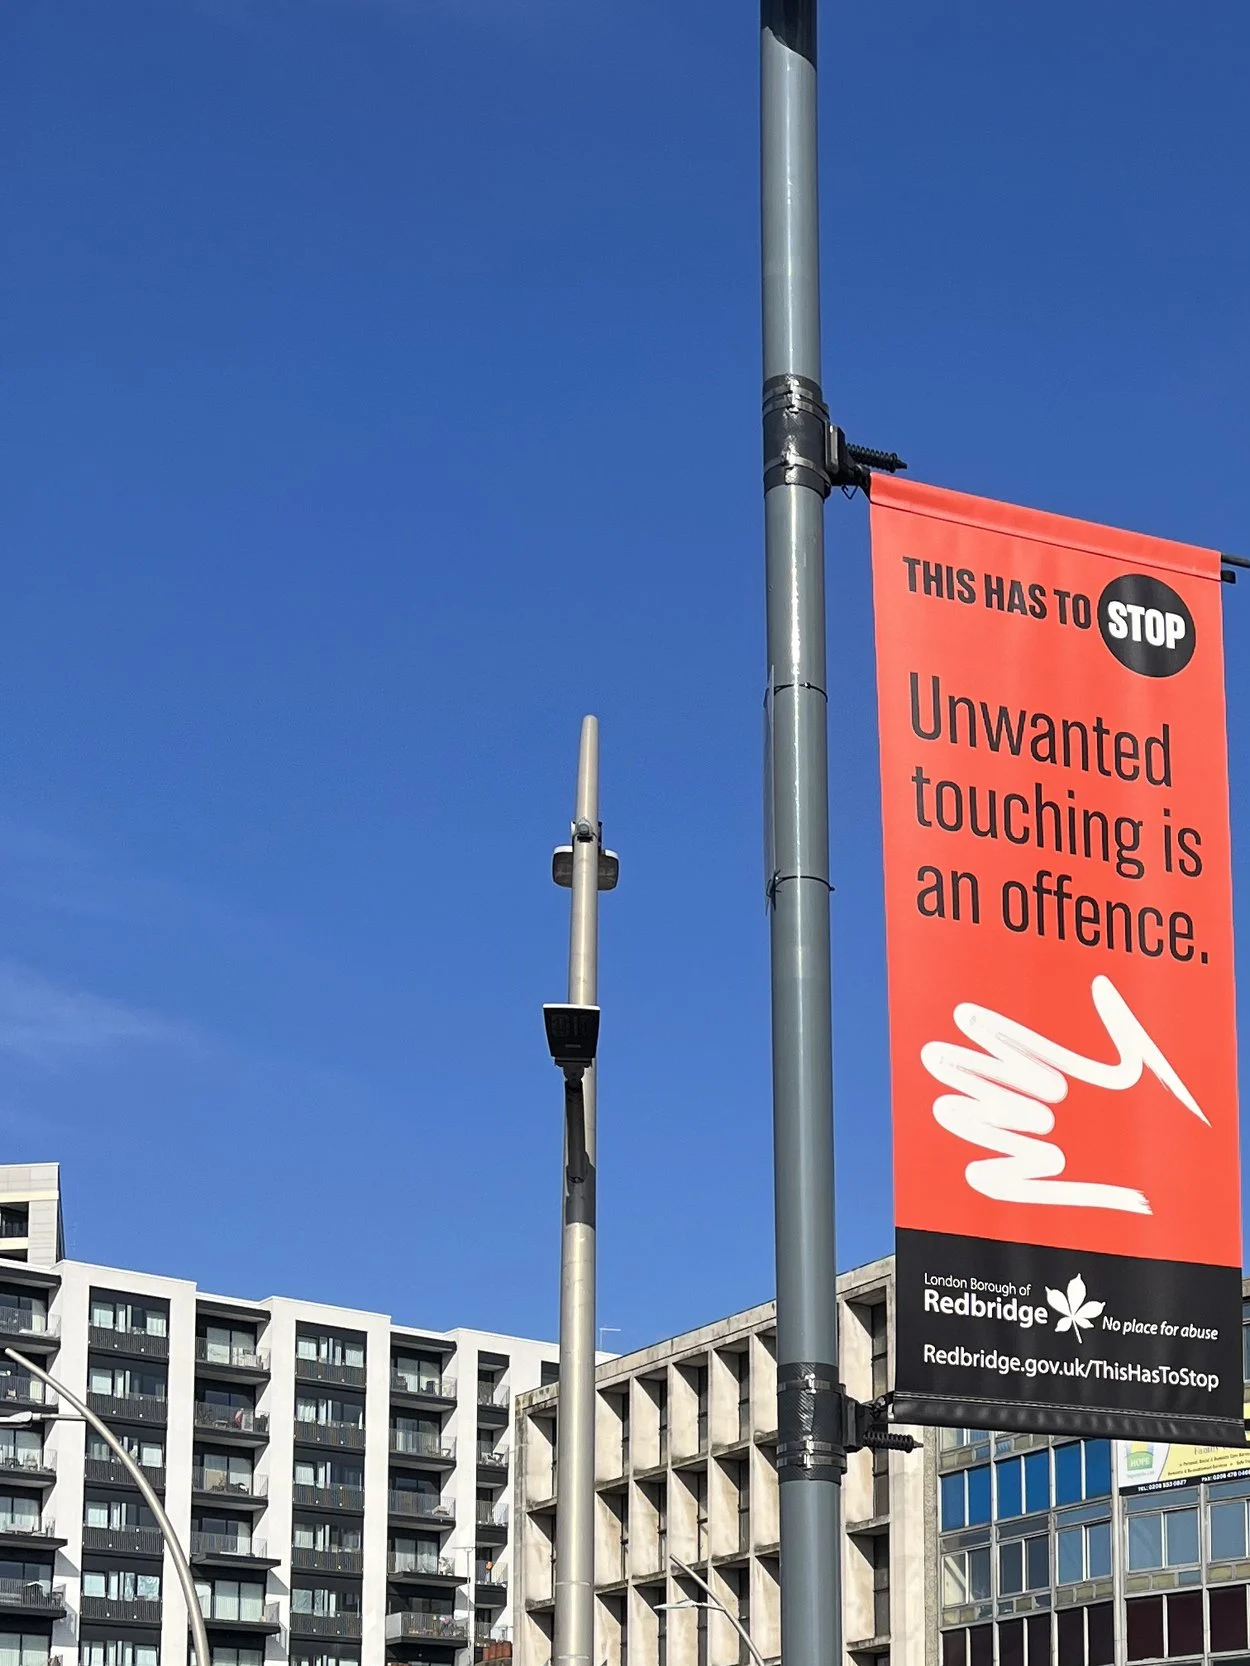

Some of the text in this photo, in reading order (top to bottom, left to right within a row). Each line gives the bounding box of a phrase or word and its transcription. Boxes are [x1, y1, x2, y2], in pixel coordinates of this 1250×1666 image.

[903, 556, 1186, 649] THIS HAS TO STOP
[908, 671, 1172, 787] Unwanted
[911, 766, 1202, 880] touching is
[916, 865, 1209, 965] an offence.
[923, 1289, 1048, 1328] Redbridge
[924, 1273, 1031, 1297] London Borough of
[1103, 1316, 1219, 1341] No place for abuse
[923, 1344, 1219, 1391] Redbridge.gov.uk/ThisHasToStop
